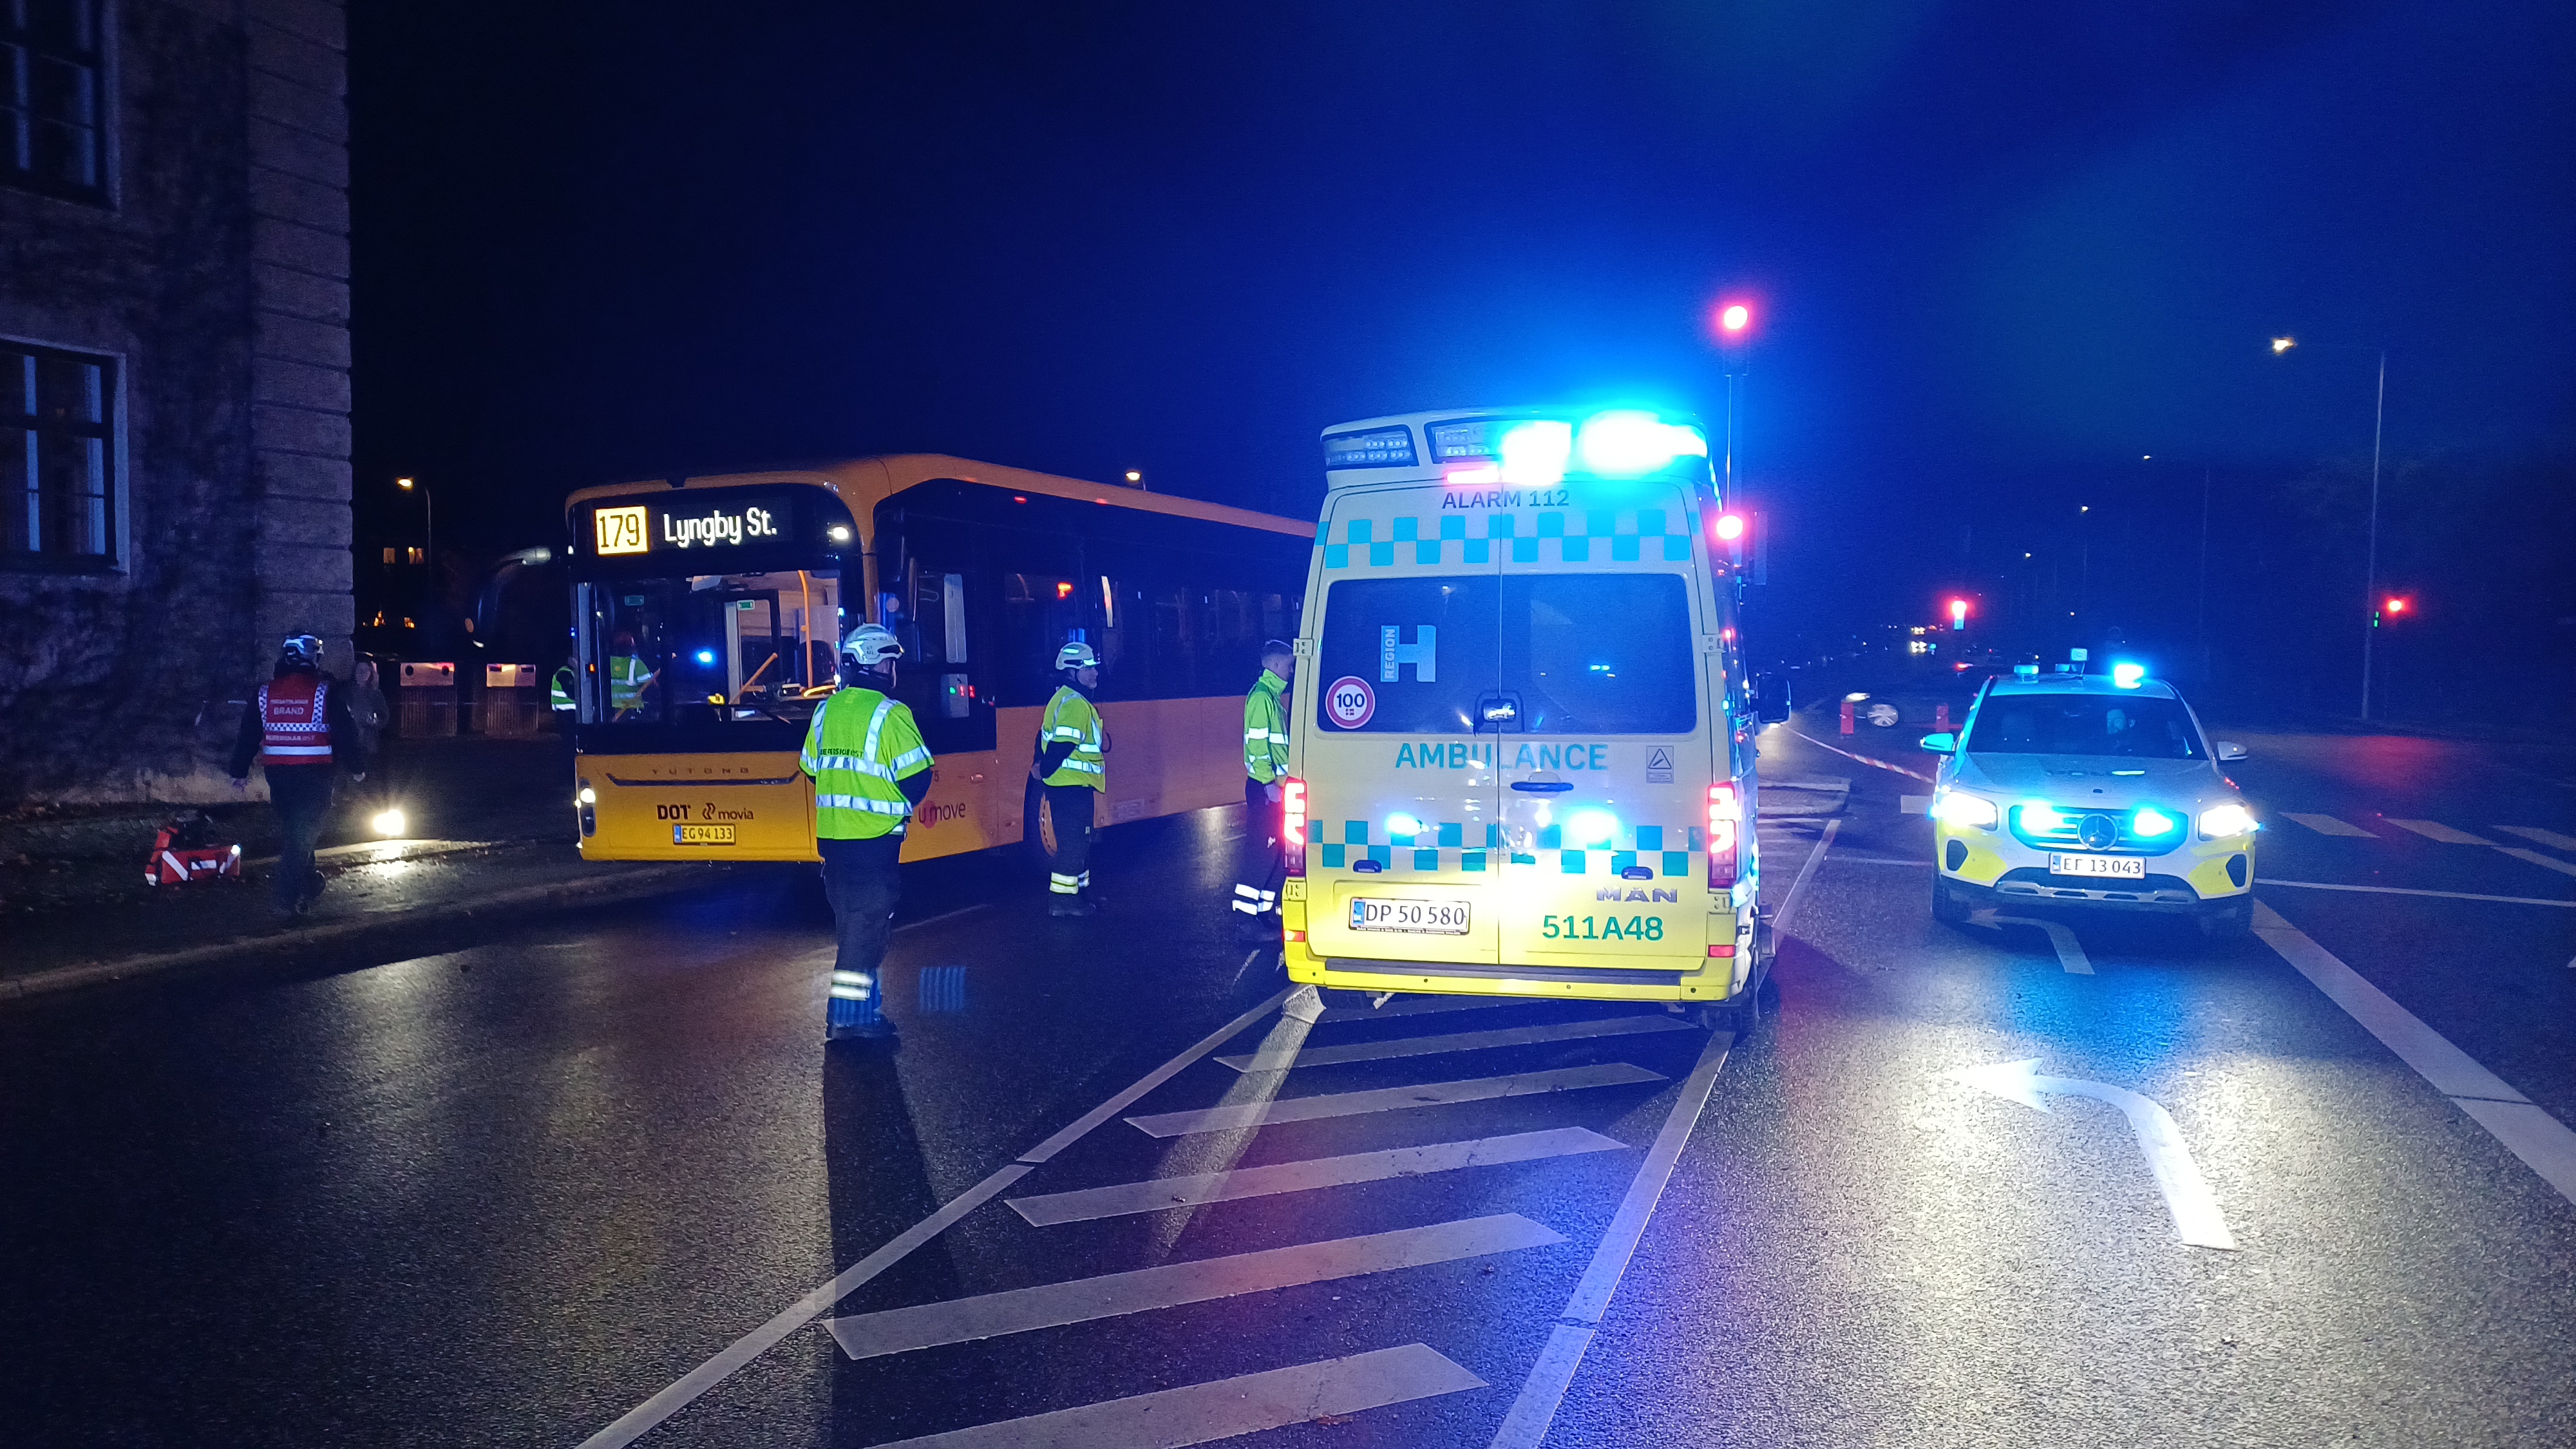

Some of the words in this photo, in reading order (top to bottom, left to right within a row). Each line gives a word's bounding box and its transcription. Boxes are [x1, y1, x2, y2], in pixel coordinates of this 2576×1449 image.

[1442, 491, 1520, 509] ALARM
[1529, 489, 1569, 507] 112
[599, 514, 640, 547] 179
[663, 509, 741, 549] Lyngby
[746, 507, 778, 536] St.
[1384, 629, 1396, 679] REGION
[1336, 693, 1365, 708] 100
[657, 804, 692, 820] DOT
[717, 808, 754, 820] movia
[681, 827, 696, 840] EG
[697, 827, 711, 840] 94
[714, 827, 732, 840] 133
[2090, 859, 2107, 873] 13
[2112, 860, 2141, 875] 043
[1596, 886, 1678, 903] MAN
[1365, 904, 1392, 922] DP
[1397, 905, 1422, 923] 50
[1427, 906, 1466, 925] 580
[1542, 914, 1664, 941] 511A48
